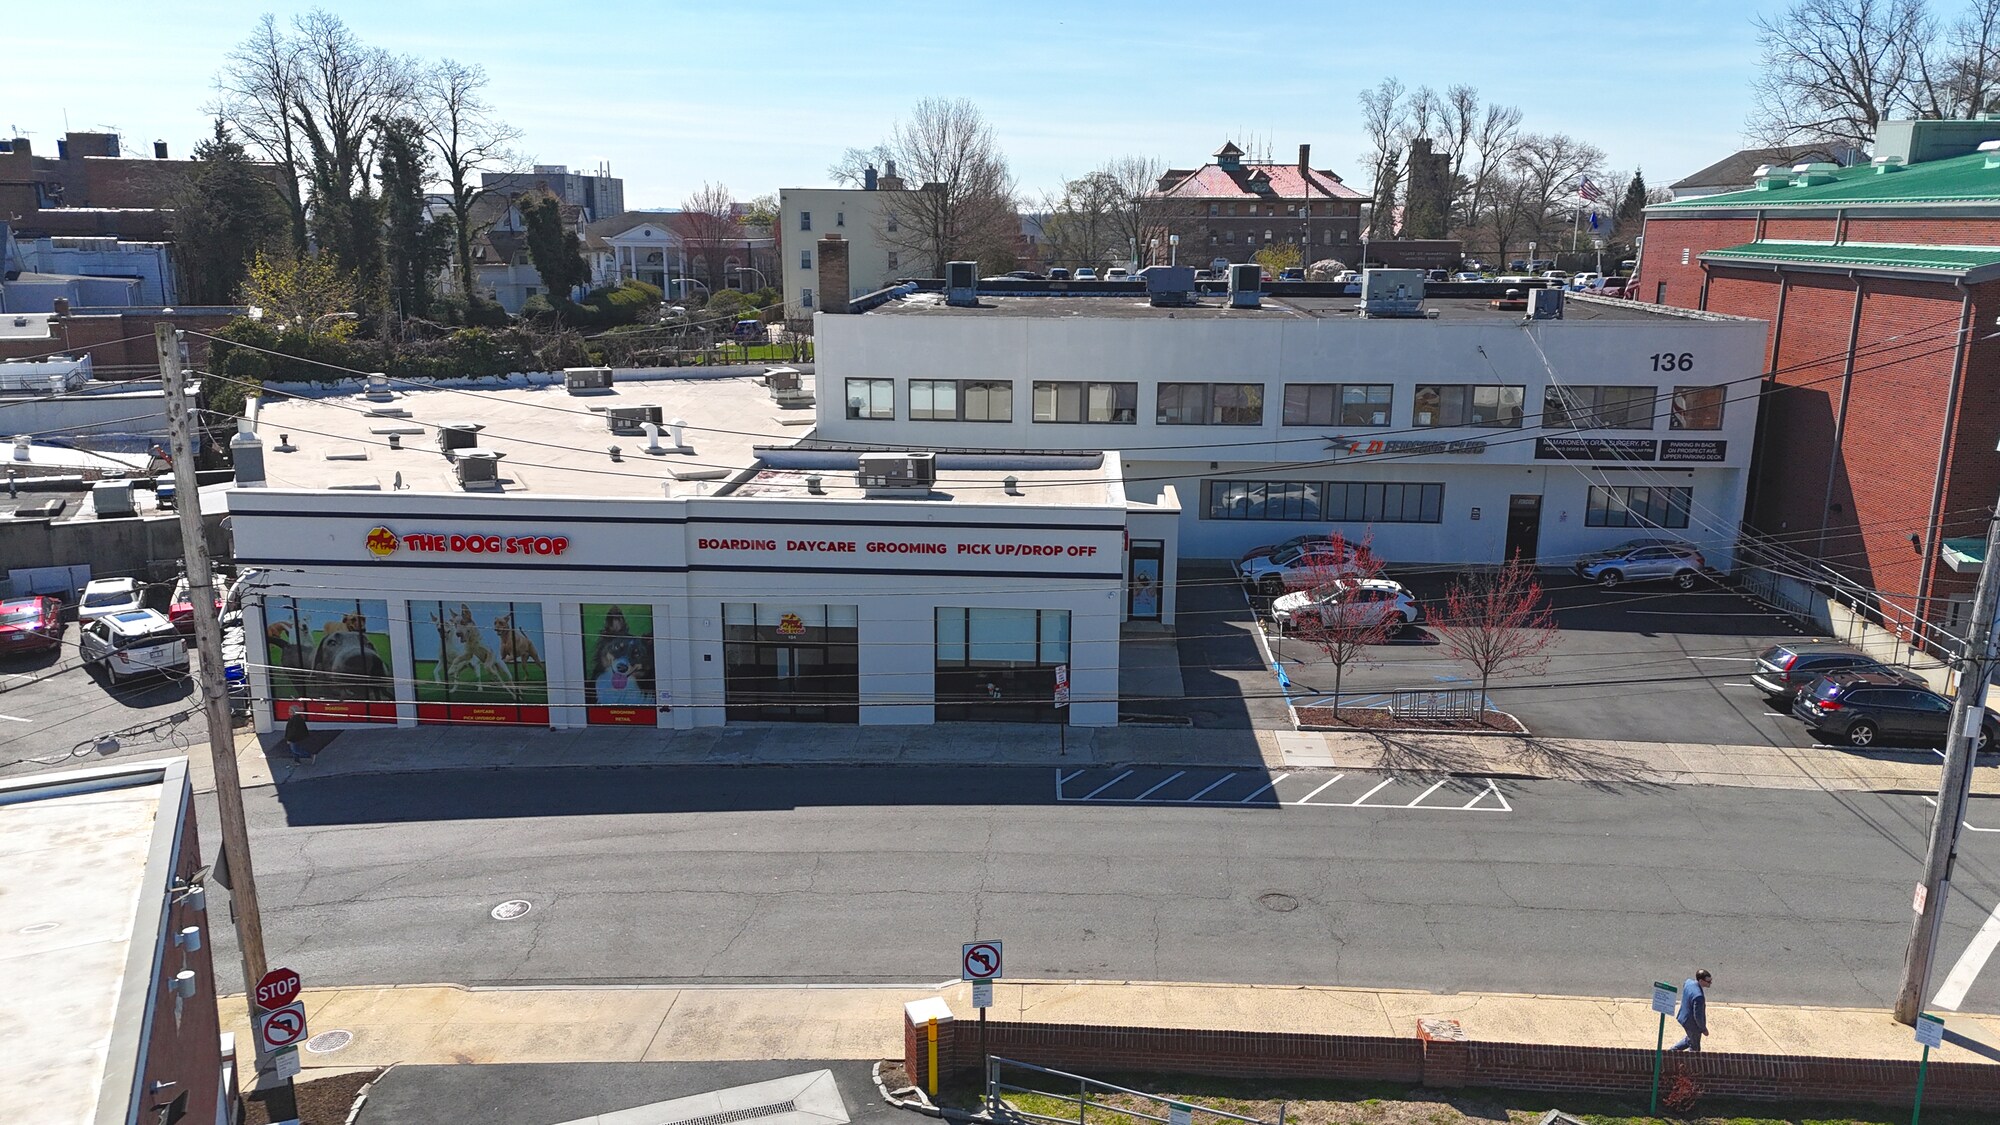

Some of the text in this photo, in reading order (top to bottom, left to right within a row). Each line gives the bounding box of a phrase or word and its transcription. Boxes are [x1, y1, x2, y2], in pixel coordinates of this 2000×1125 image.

[1650, 352, 1694, 372] 136
[402, 534, 568, 556] THE DOG STOP
[698, 538, 1098, 557] BOARDING DAYCARE GROOMING PICK UP/DROP OFF
[259, 977, 298, 1002] STOP
